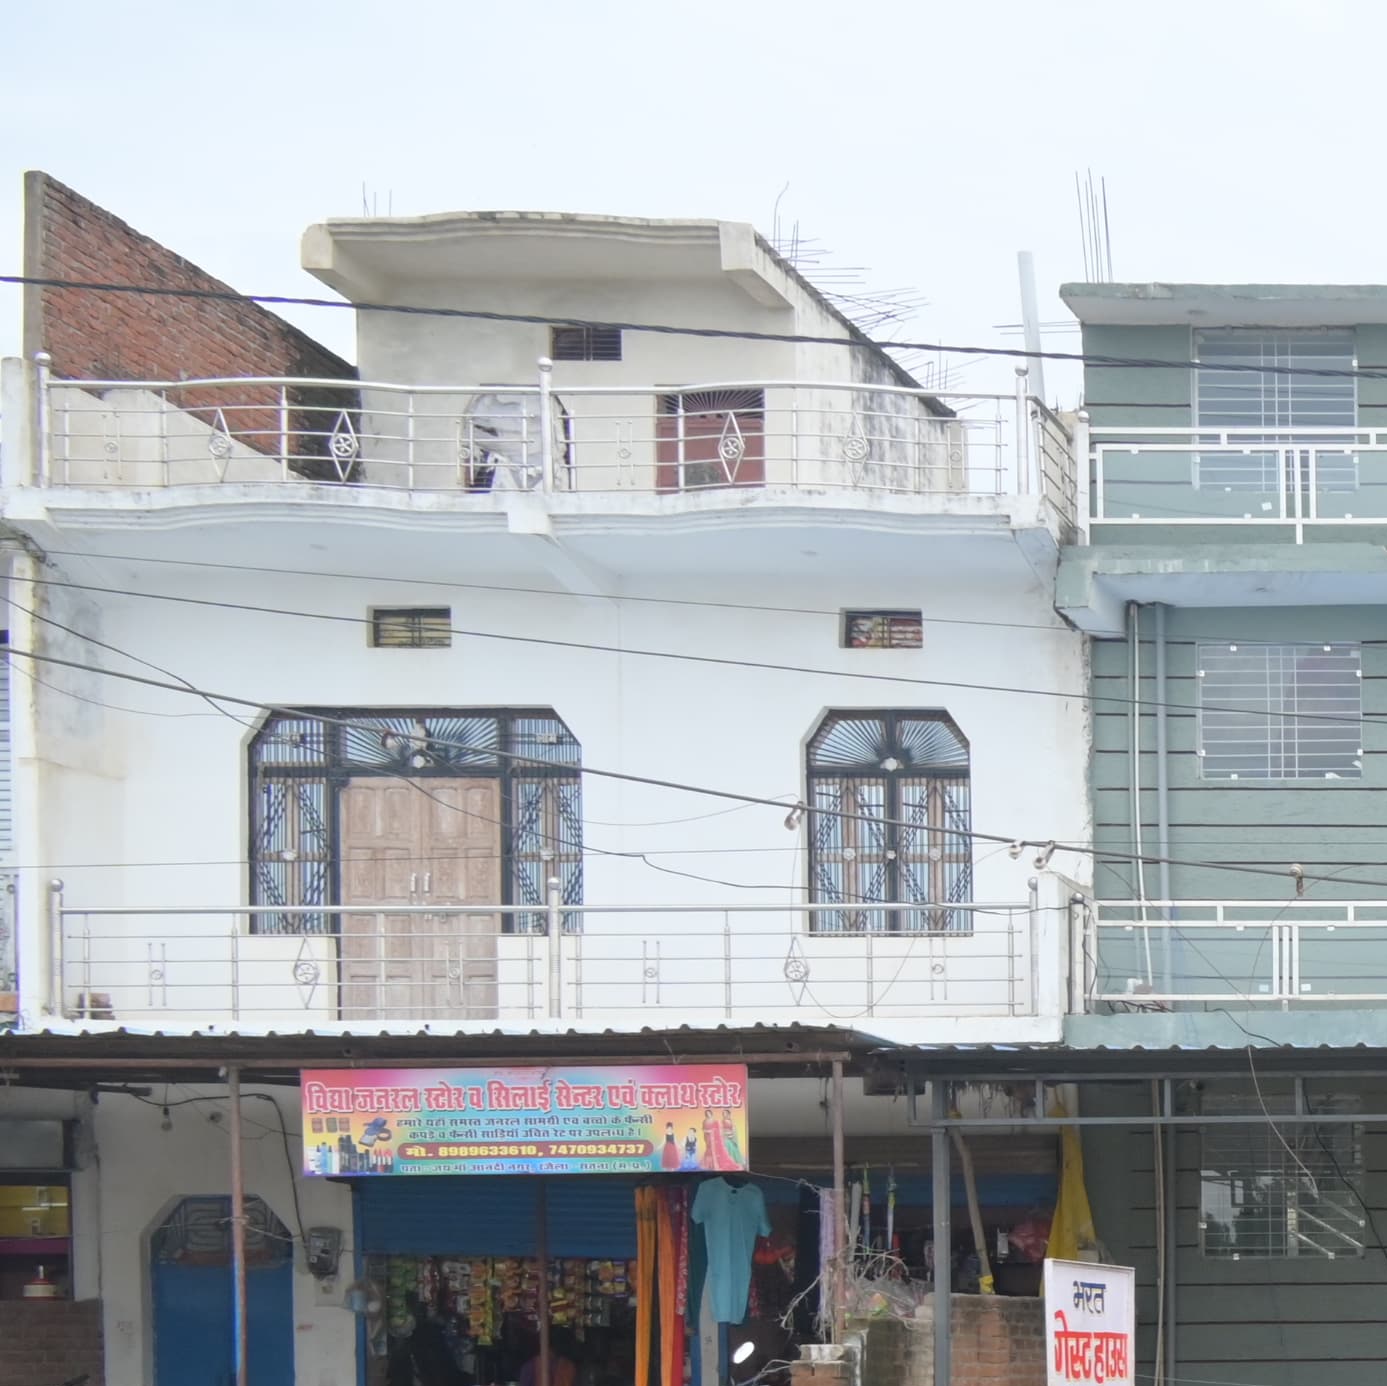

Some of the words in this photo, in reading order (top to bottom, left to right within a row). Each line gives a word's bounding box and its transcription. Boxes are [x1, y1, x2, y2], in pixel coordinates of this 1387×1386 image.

[305, 1081, 353, 1113] विद्या
[354, 1087, 421, 1112] जनरल
[424, 1079, 466, 1111] स्टोर
[467, 1085, 484, 1111] व
[486, 1080, 553, 1114] सिलाई
[556, 1079, 606, 1110] सेन्टर
[607, 1079, 638, 1110] एवं
[640, 1083, 698, 1109] क्लाथ
[698, 1075, 743, 1108] स्टोर
[485, 1117, 520, 1127] जनरल
[549, 1143, 645, 1155] 7470934737
[1054, 1309, 1092, 1380] गेस्ट
[1093, 1331, 1129, 1384] हाउस
